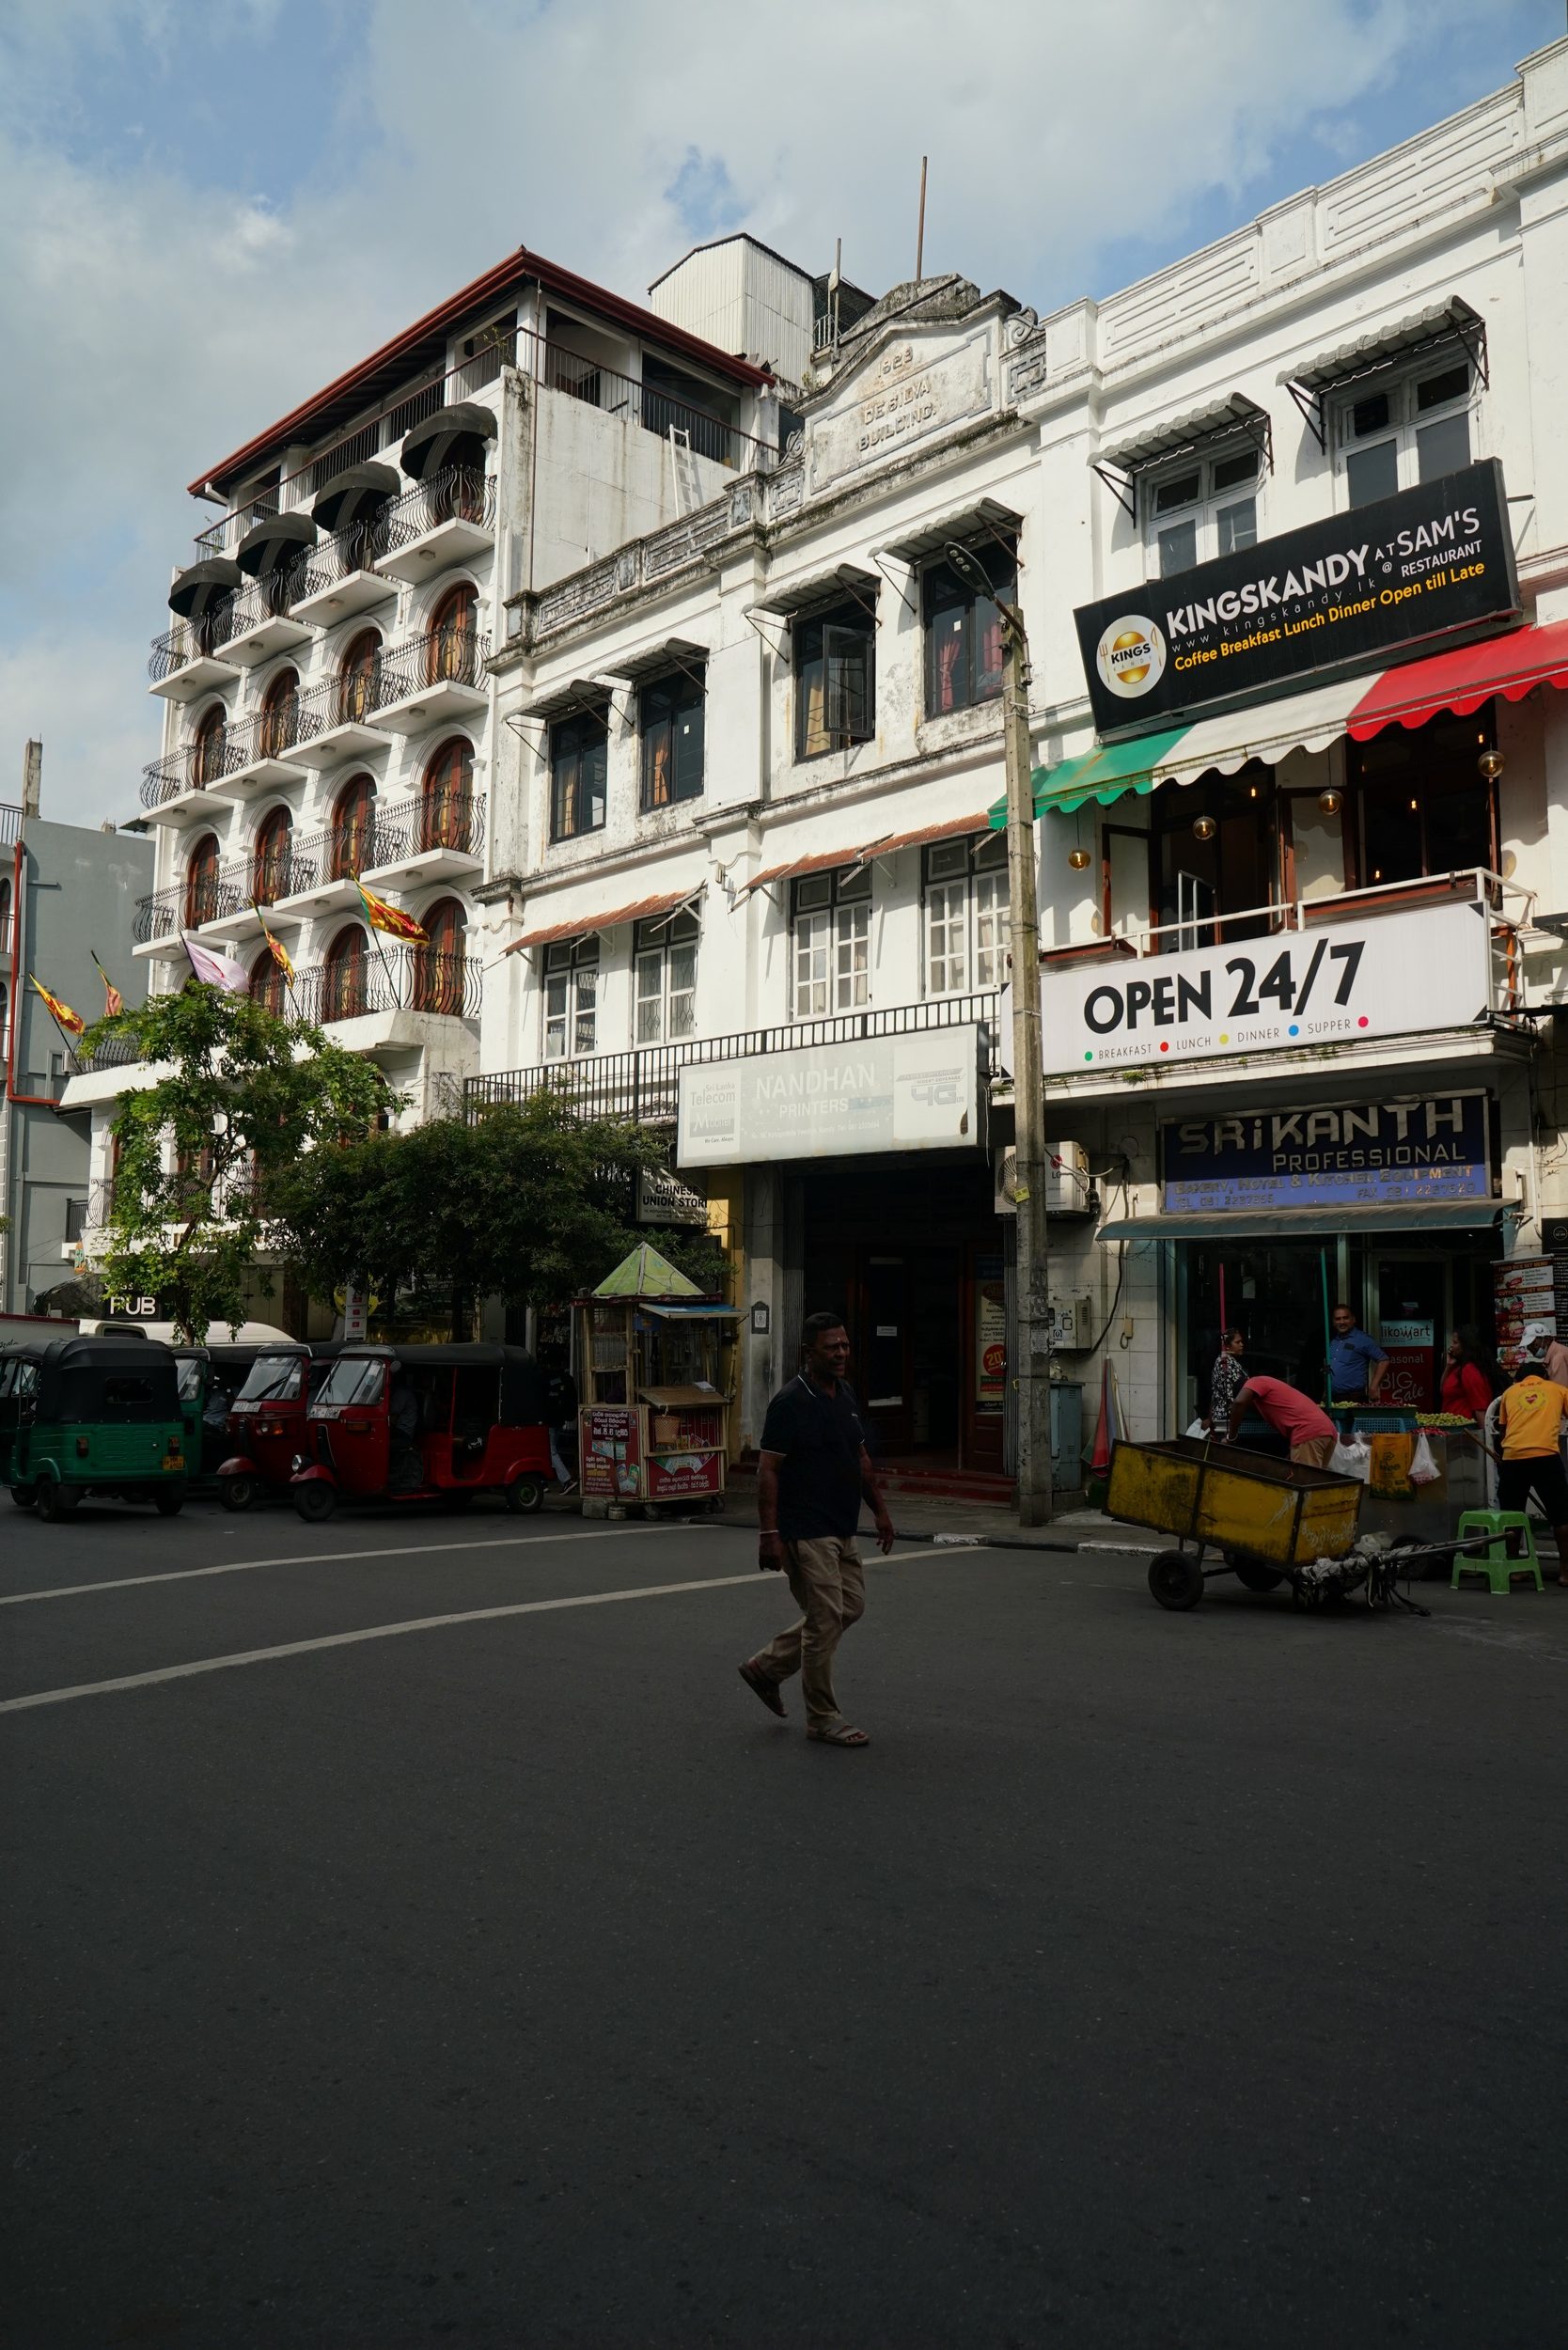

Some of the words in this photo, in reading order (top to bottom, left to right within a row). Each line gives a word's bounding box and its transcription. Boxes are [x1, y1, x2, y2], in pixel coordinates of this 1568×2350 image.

[864, 401, 886, 425] DE
[888, 379, 932, 413] SILVA
[1401, 540, 1482, 578] RESTAURANT
[1166, 543, 1370, 640] KINGSKANDY
[1397, 507, 1481, 557] SAM'S
[1174, 649, 1218, 671] Coffee
[1220, 628, 1282, 660] Breakfast
[1284, 612, 1325, 648] Lunch
[1328, 596, 1376, 622] Dinner
[1380, 583, 1422, 610] Open
[1424, 570, 1447, 598] till
[1450, 560, 1485, 588] Late
[1110, 640, 1152, 665] KINGS
[1084, 969, 1212, 1035] OPEN
[1225, 938, 1366, 1018] 24/7
[1098, 1042, 1152, 1060] BREAKFAST
[1176, 1036, 1212, 1051] LUNCH
[1237, 1026, 1279, 1043] DINNER
[1307, 1018, 1351, 1035] SUPPER
[756, 1062, 875, 1100] NANDHAN
[691, 1089, 735, 1106] Telecom
[779, 1098, 849, 1119] PRINTERS
[1272, 1142, 1466, 1173] PROFESSIONAL
[655, 1184, 698, 1196] CHINESE
[1290, 1174, 1301, 1187] &
[643, 1195, 675, 1207] UNION
[1356, 1187, 1378, 1198] FAX
[110, 1296, 156, 1315] PUB
[1380, 1371, 1414, 1390] BIG
[1391, 1384, 1425, 1404] Sale
